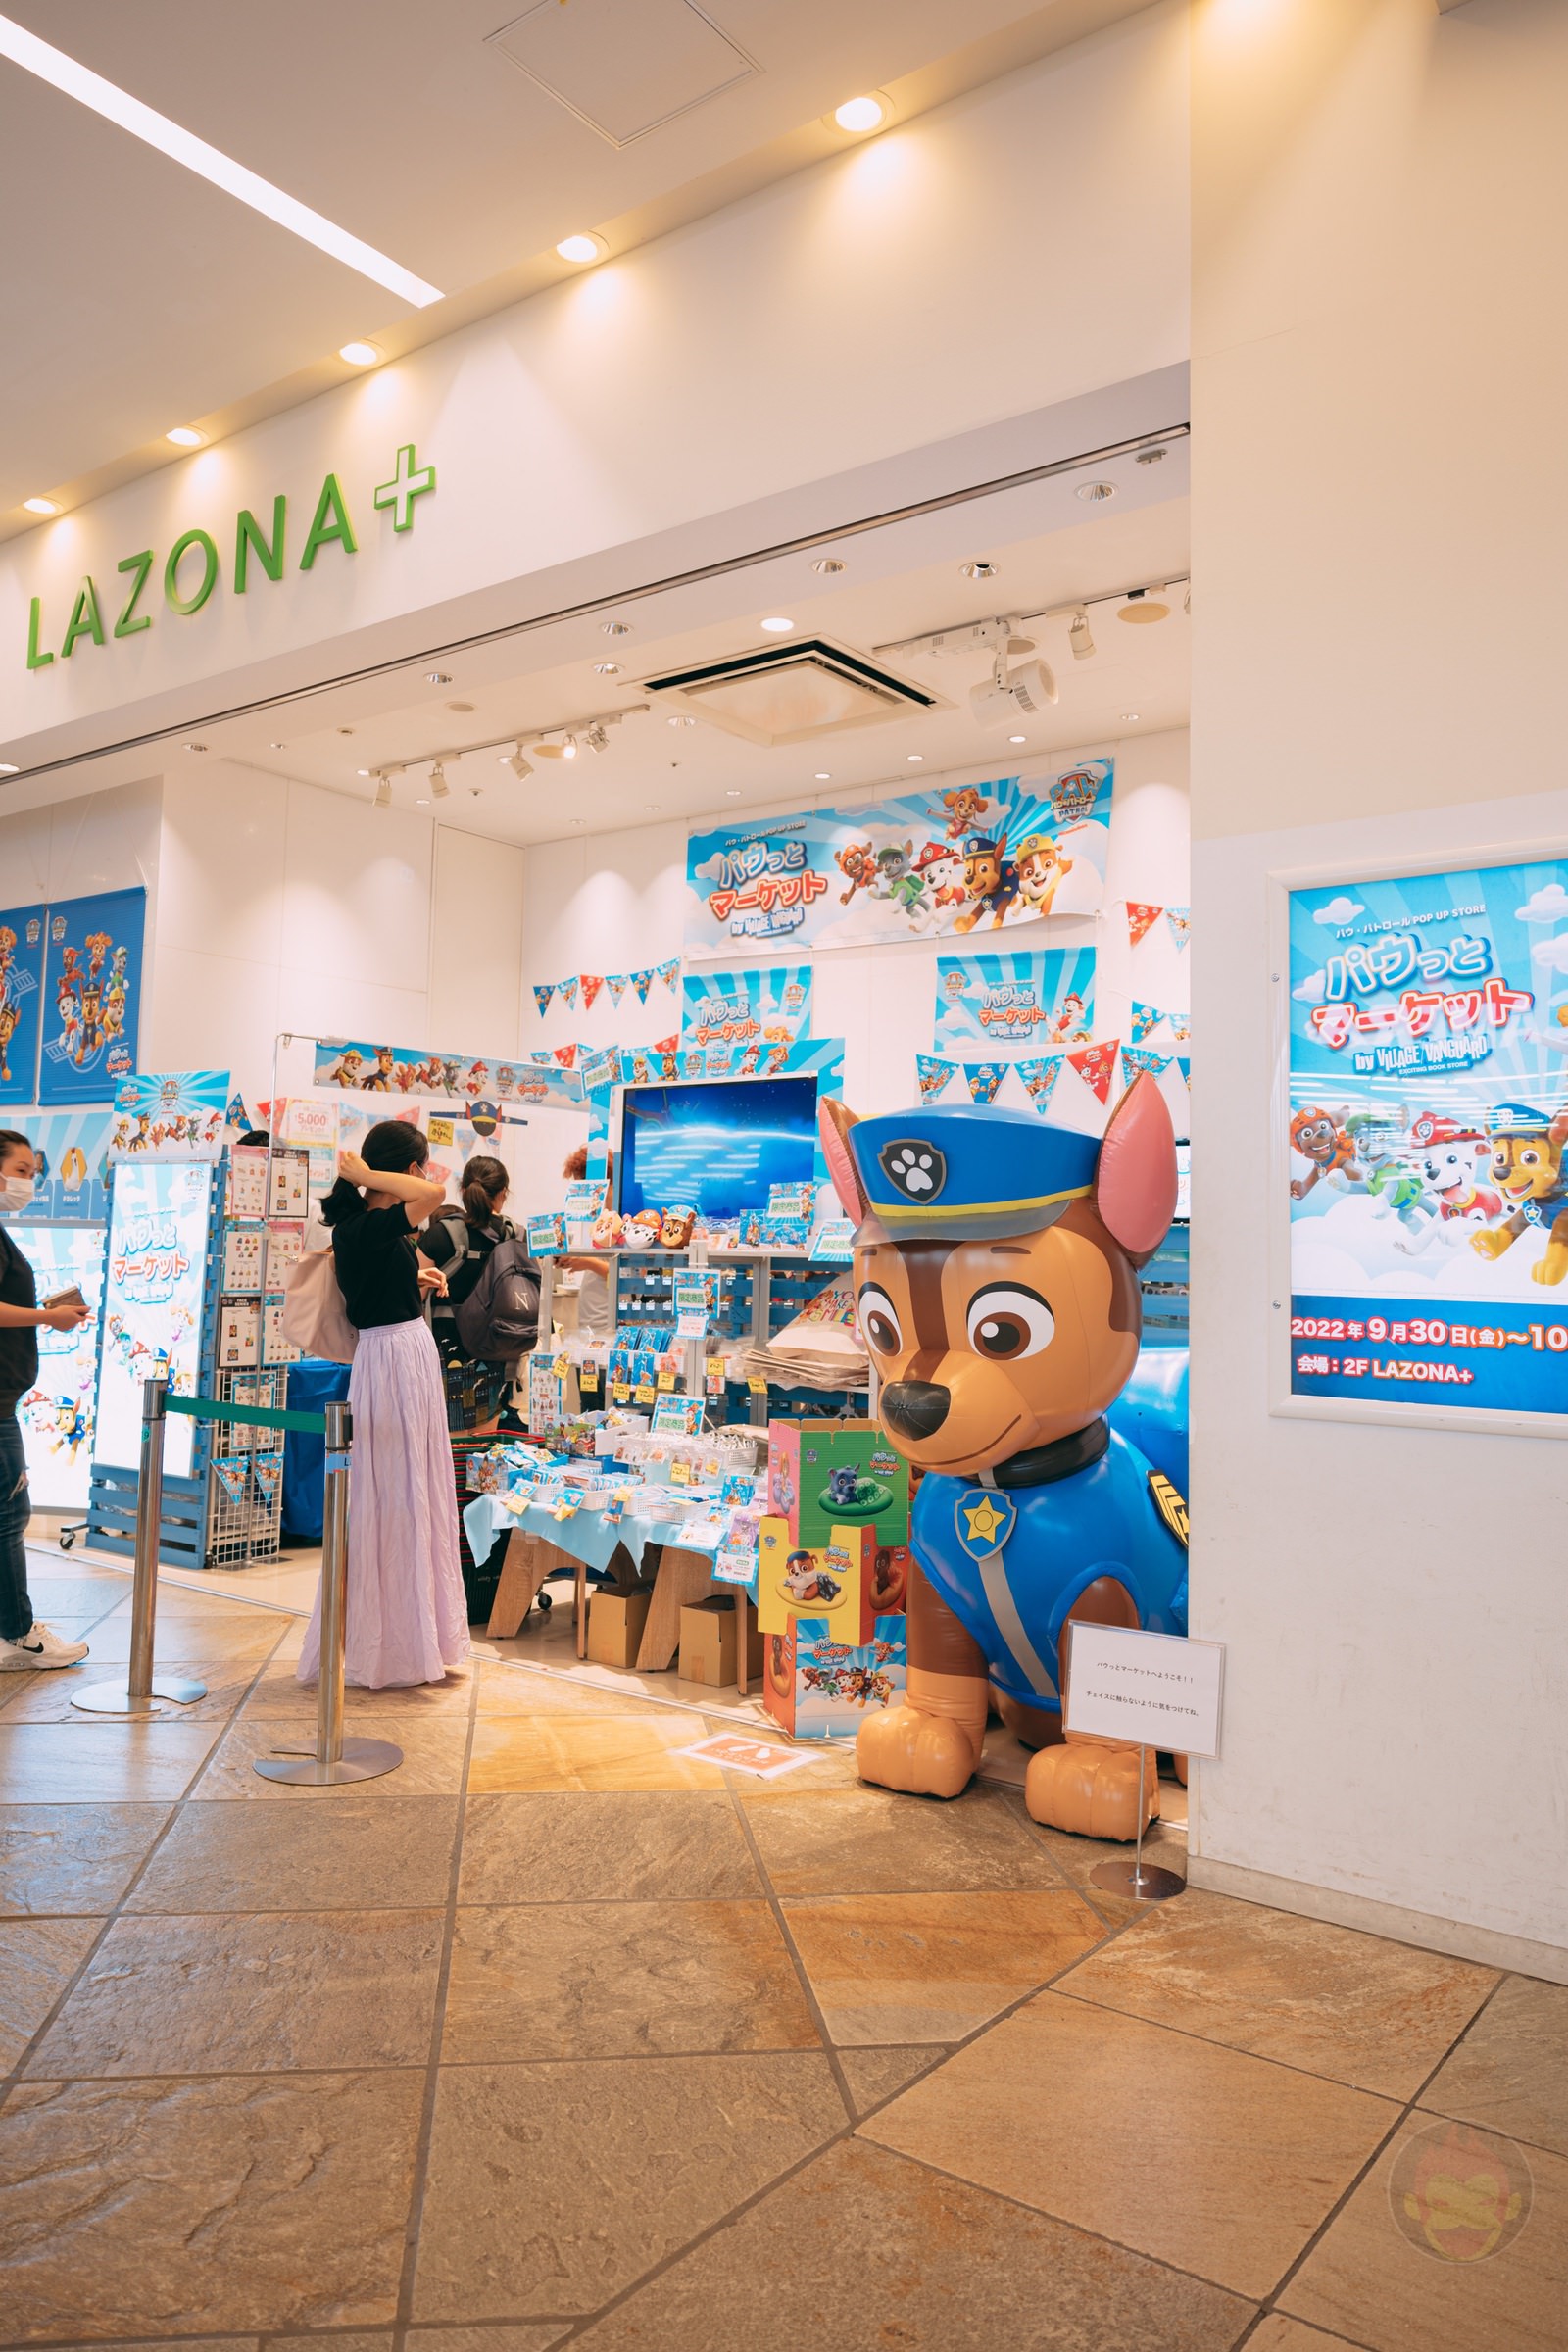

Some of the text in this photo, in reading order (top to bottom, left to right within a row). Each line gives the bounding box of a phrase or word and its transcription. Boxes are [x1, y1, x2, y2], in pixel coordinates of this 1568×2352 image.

[718, 841, 807, 890] パウっと
[710, 870, 828, 921] マーケット
[1413, 913, 1433, 925] POP
[1436, 909, 1449, 920] UP
[1451, 904, 1486, 918] STORE
[1325, 934, 1492, 1001] パウっと
[978, 1005, 1046, 1028] マーケット
[1310, 978, 1534, 1050] マーケット
[696, 1019, 760, 1046] マーケット
[1354, 1054, 1374, 1070] by
[113, 1250, 190, 1285] マーケット
[808, 1308, 855, 1327] SMILE
[1373, 1360, 1472, 1383] LAZONA+
